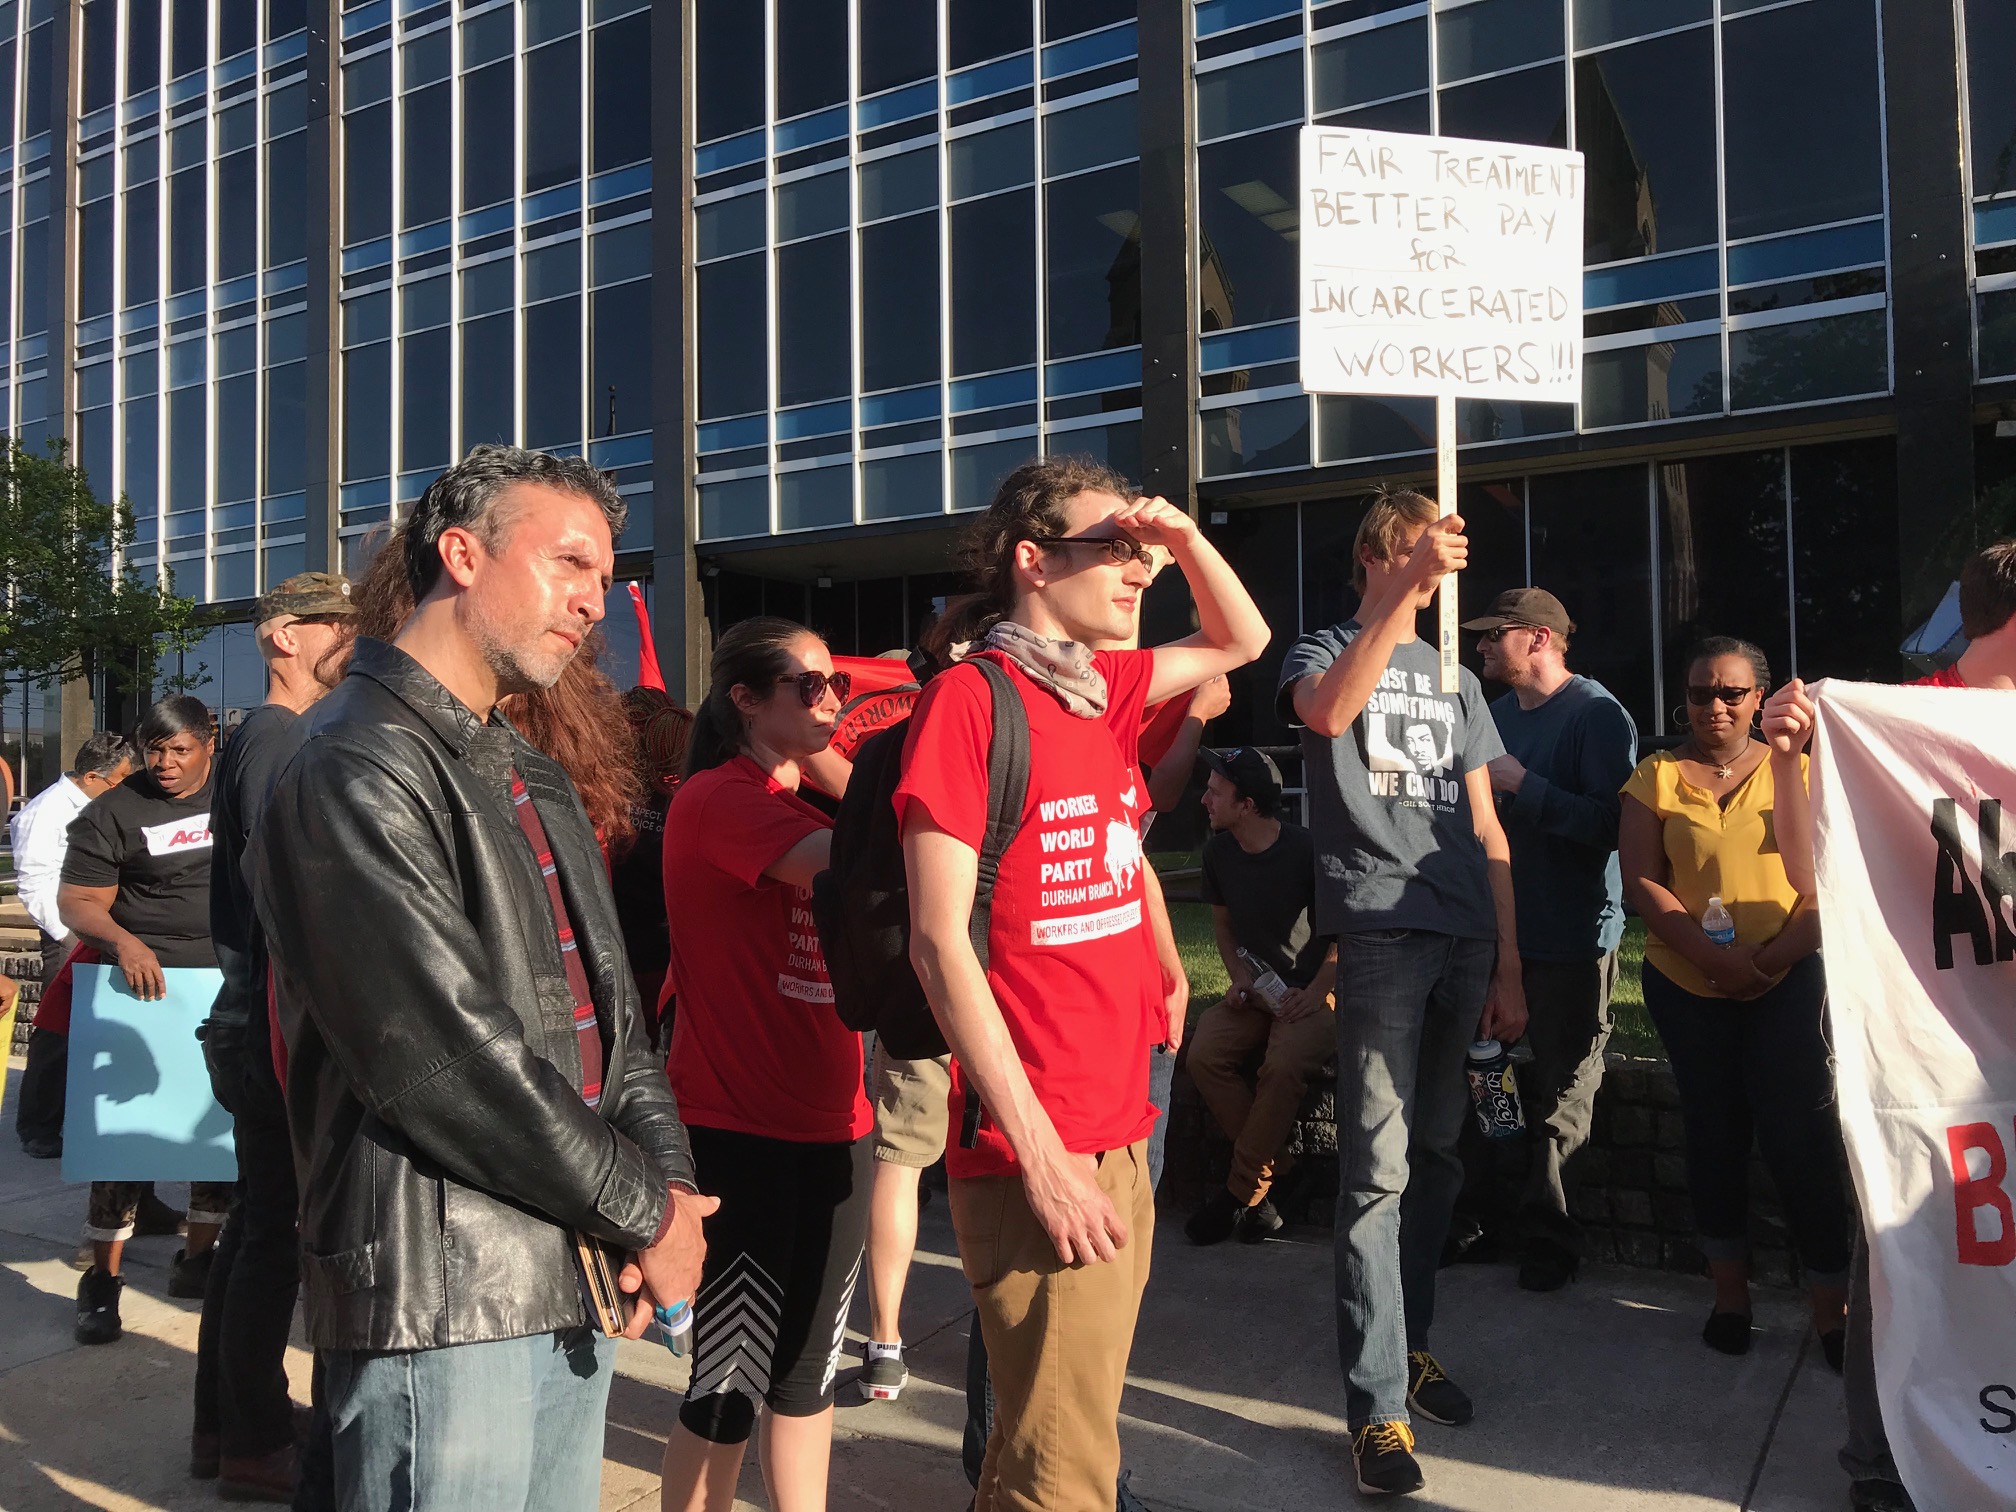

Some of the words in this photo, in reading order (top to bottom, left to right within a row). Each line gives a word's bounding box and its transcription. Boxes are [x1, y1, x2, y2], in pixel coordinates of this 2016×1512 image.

[1428, 149, 1583, 199] TREATMENT
[1309, 188, 1469, 233] BETTER
[1497, 203, 1556, 244] PAY
[1308, 278, 1568, 324] INCARCERATED
[1333, 339, 1575, 384] WORKERS!!!
[1376, 667, 1408, 692] UST
[1414, 672, 1433, 696] BE
[1368, 772, 1400, 797] WE
[1406, 772, 1436, 801] CAN
[1438, 777, 1460, 805] DO
[630, 816, 655, 831] OICE
[631, 805, 662, 821] ESPECT,
[1040, 826, 1095, 853] WORLD
[1041, 858, 1092, 884] PARTY
[1041, 886, 1087, 907] DURHAM
[1088, 880, 1114, 901] BRANCH
[788, 931, 819, 953] PART
[1036, 923, 1079, 939] WORKERS
[1080, 920, 1095, 934] AND
